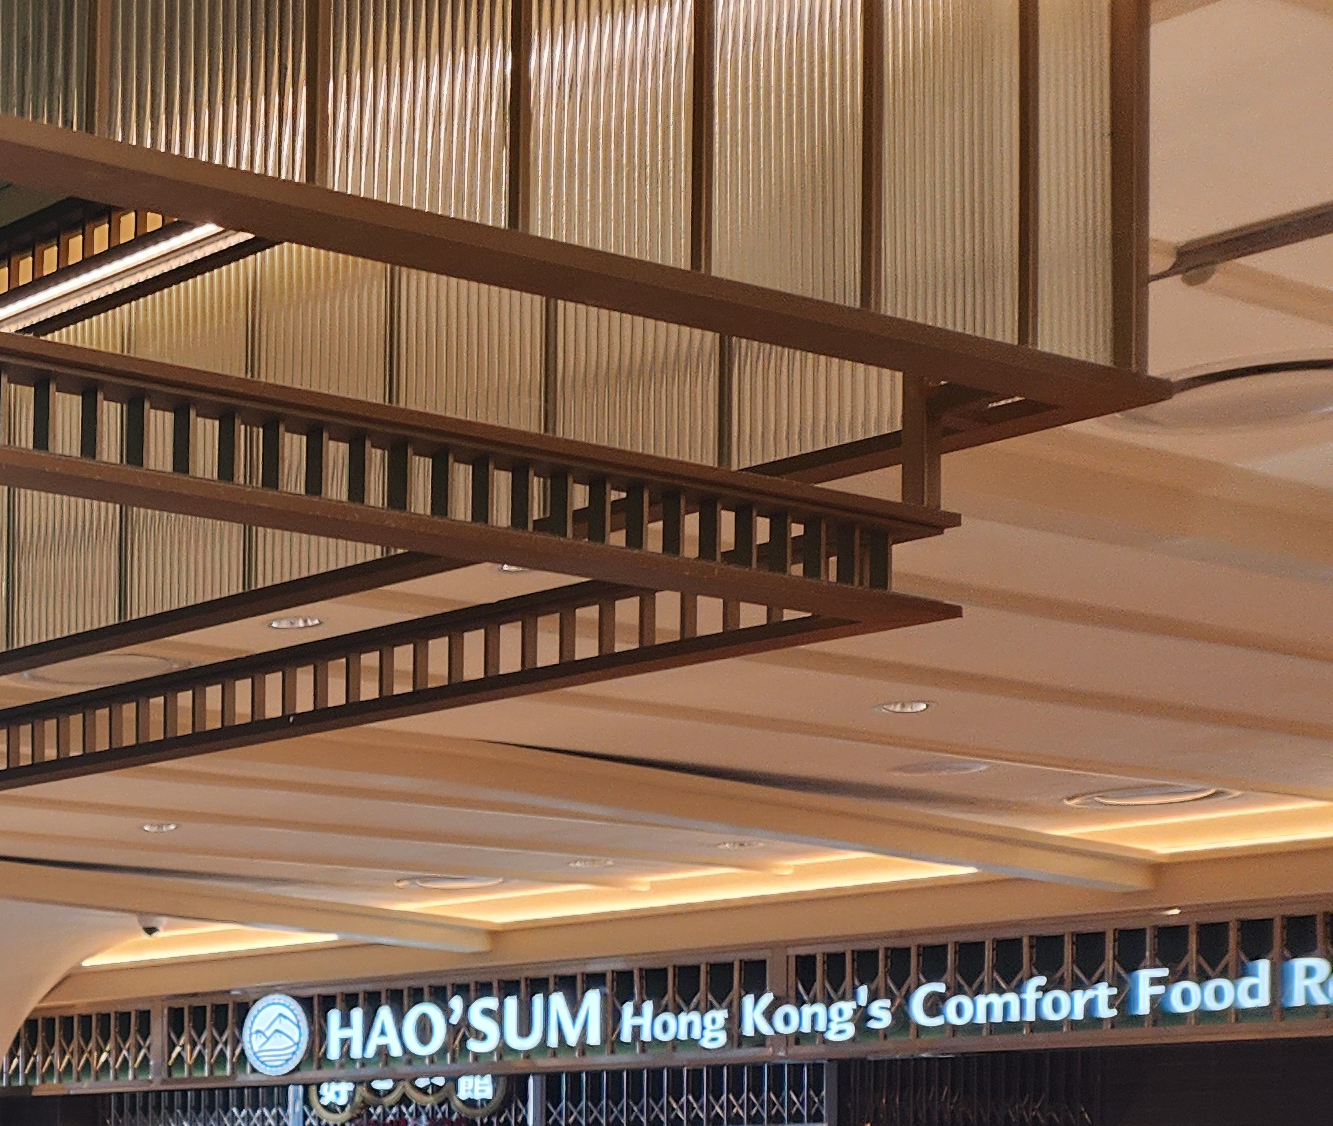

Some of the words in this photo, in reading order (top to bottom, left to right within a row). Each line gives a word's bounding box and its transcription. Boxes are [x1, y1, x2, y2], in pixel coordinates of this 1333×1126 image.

[326, 989, 601, 1061] HAO'SUM
[619, 1000, 729, 1049] Hong
[740, 984, 892, 1042] Kong's
[911, 975, 1118, 1027] Comfort
[1130, 958, 1271, 1016] Food
[1283, 957, 1333, 1008] R
